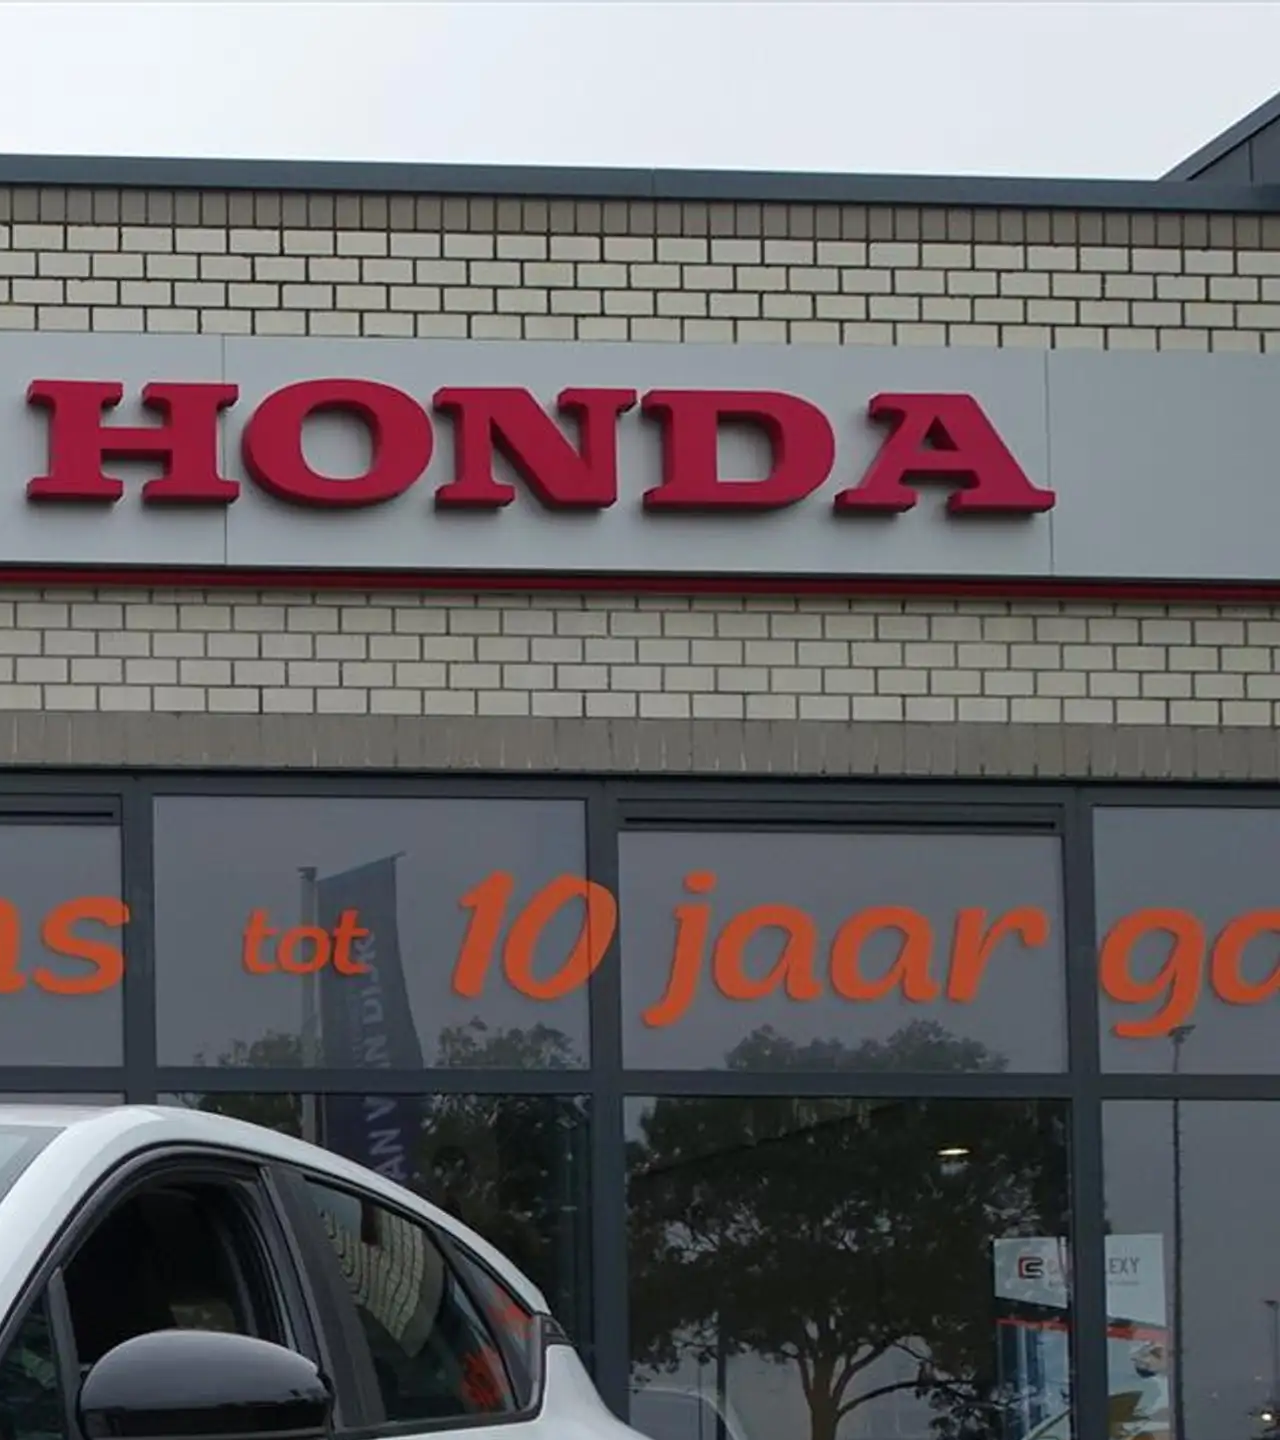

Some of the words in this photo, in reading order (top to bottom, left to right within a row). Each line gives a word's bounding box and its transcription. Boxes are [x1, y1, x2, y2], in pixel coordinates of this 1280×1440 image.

[26, 377, 1056, 512] HONDA
[241, 908, 370, 976] tot
[451, 870, 619, 1001] 10
[640, 870, 1050, 1029] jaar
